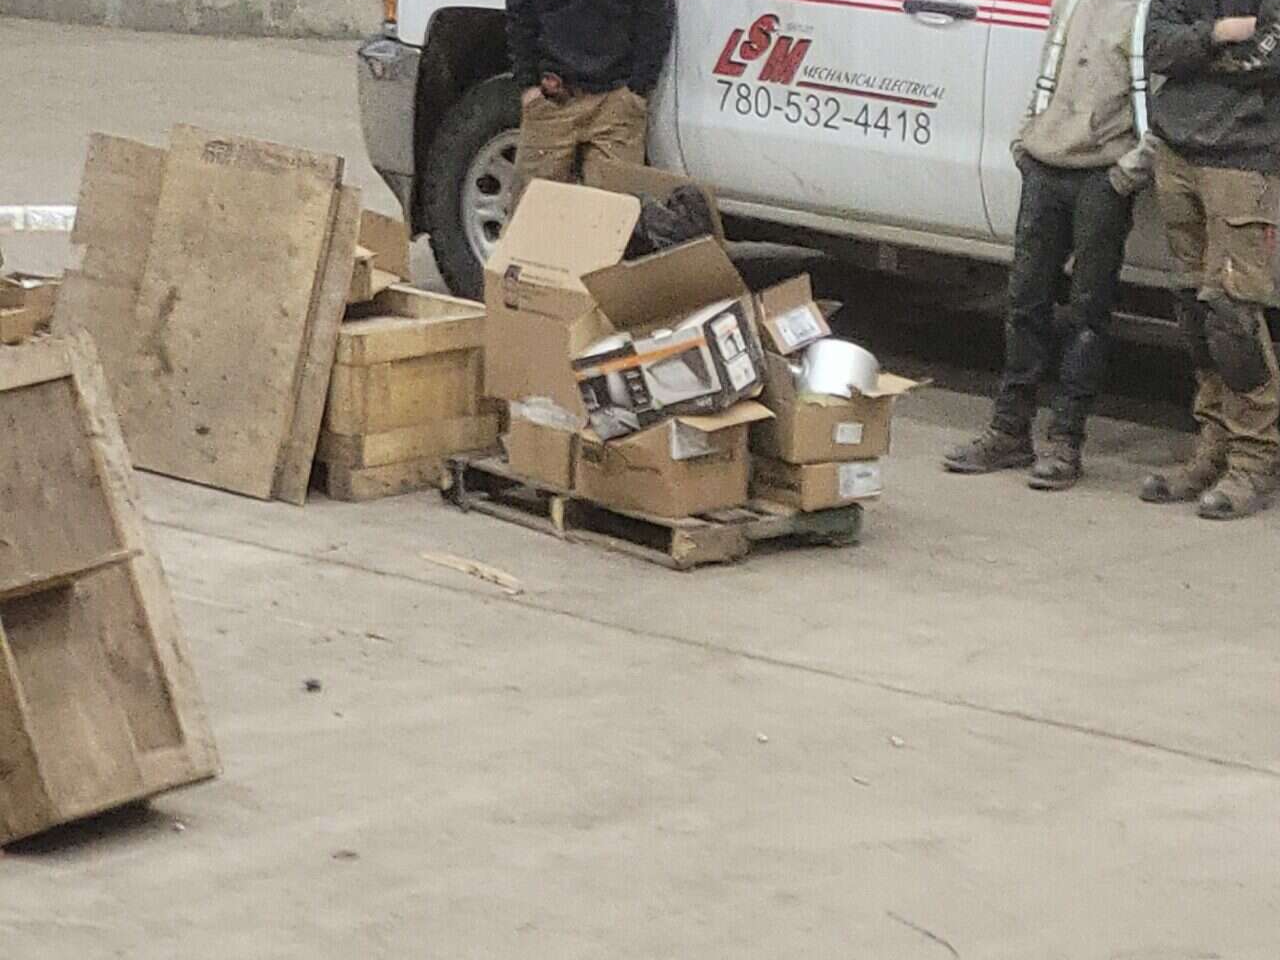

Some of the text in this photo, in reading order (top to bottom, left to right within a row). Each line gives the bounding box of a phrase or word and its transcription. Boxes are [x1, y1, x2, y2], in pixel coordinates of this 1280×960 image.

[712, 13, 813, 86] LSM
[803, 64, 945, 100] MECHANICAL ELECTRICAL
[717, 80, 932, 145] 780-532-4418
